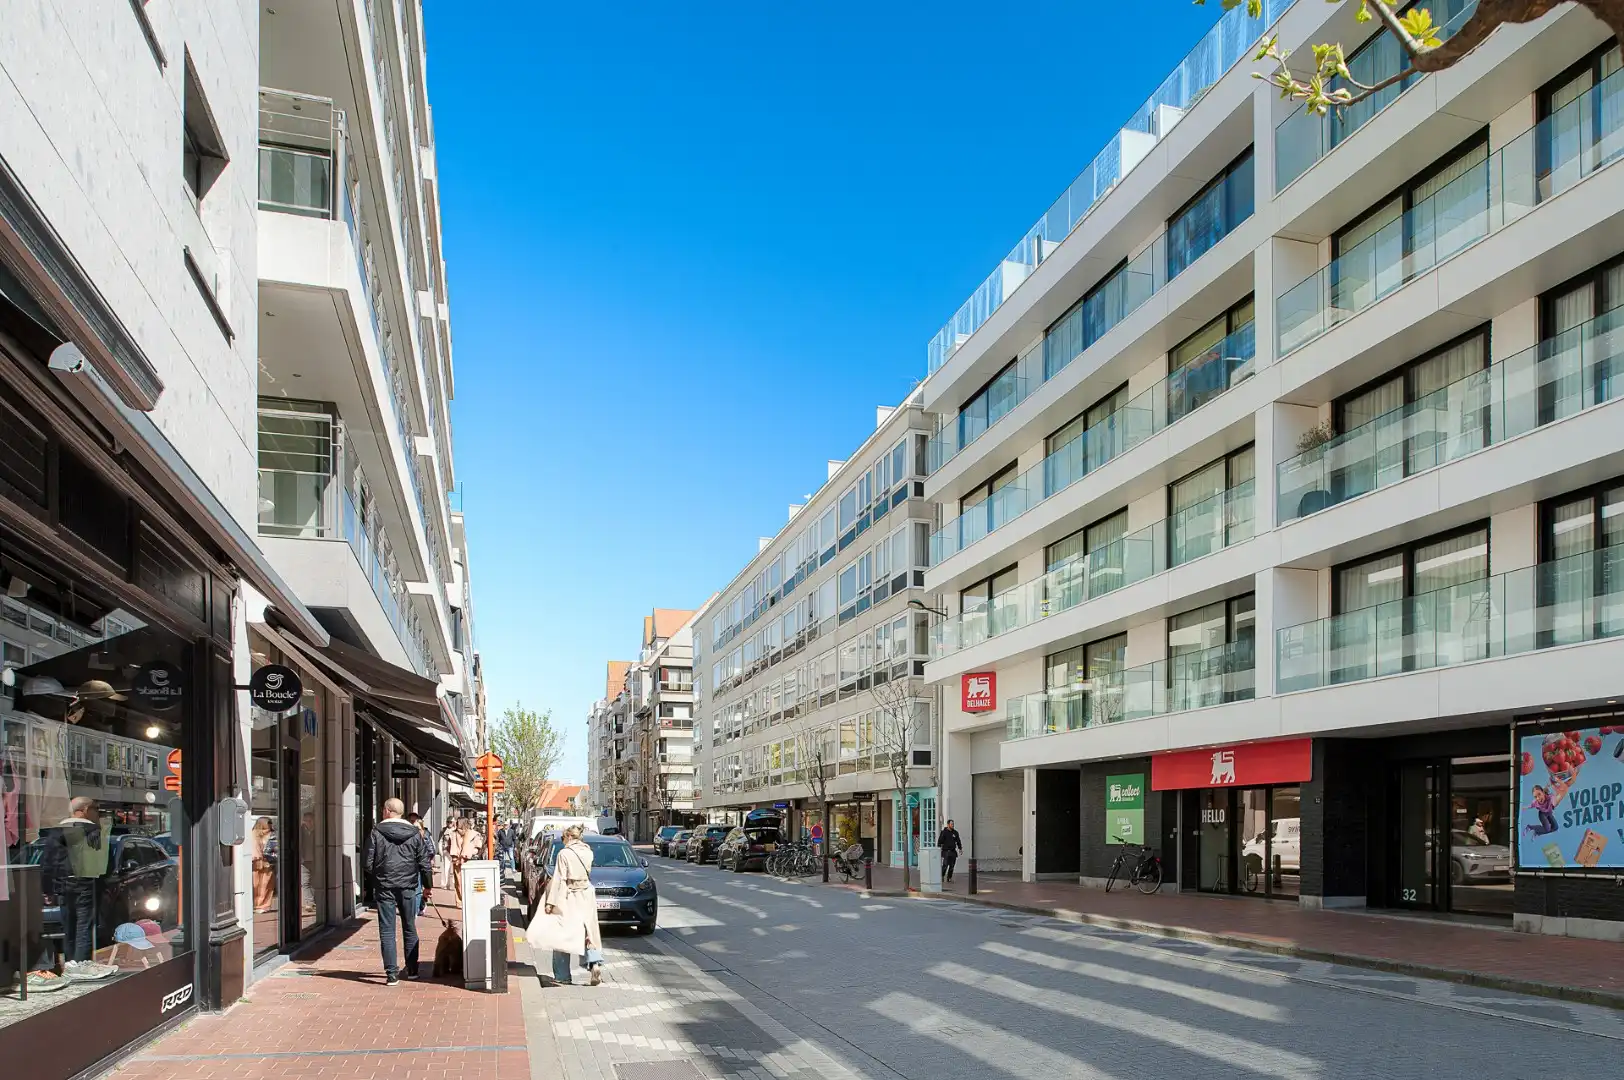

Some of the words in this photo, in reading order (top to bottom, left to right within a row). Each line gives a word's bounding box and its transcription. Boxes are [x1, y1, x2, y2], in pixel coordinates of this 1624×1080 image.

[253, 689, 264, 698] La
[966, 698, 991, 708] DELHAIZE
[1121, 784, 1140, 797] collect
[1569, 782, 1622, 809] VOLOP
[1201, 809, 1225, 823] HELLO
[1562, 801, 1614, 829] START
[1402, 888, 1416, 901] 32
[162, 984, 192, 1012] RRD
